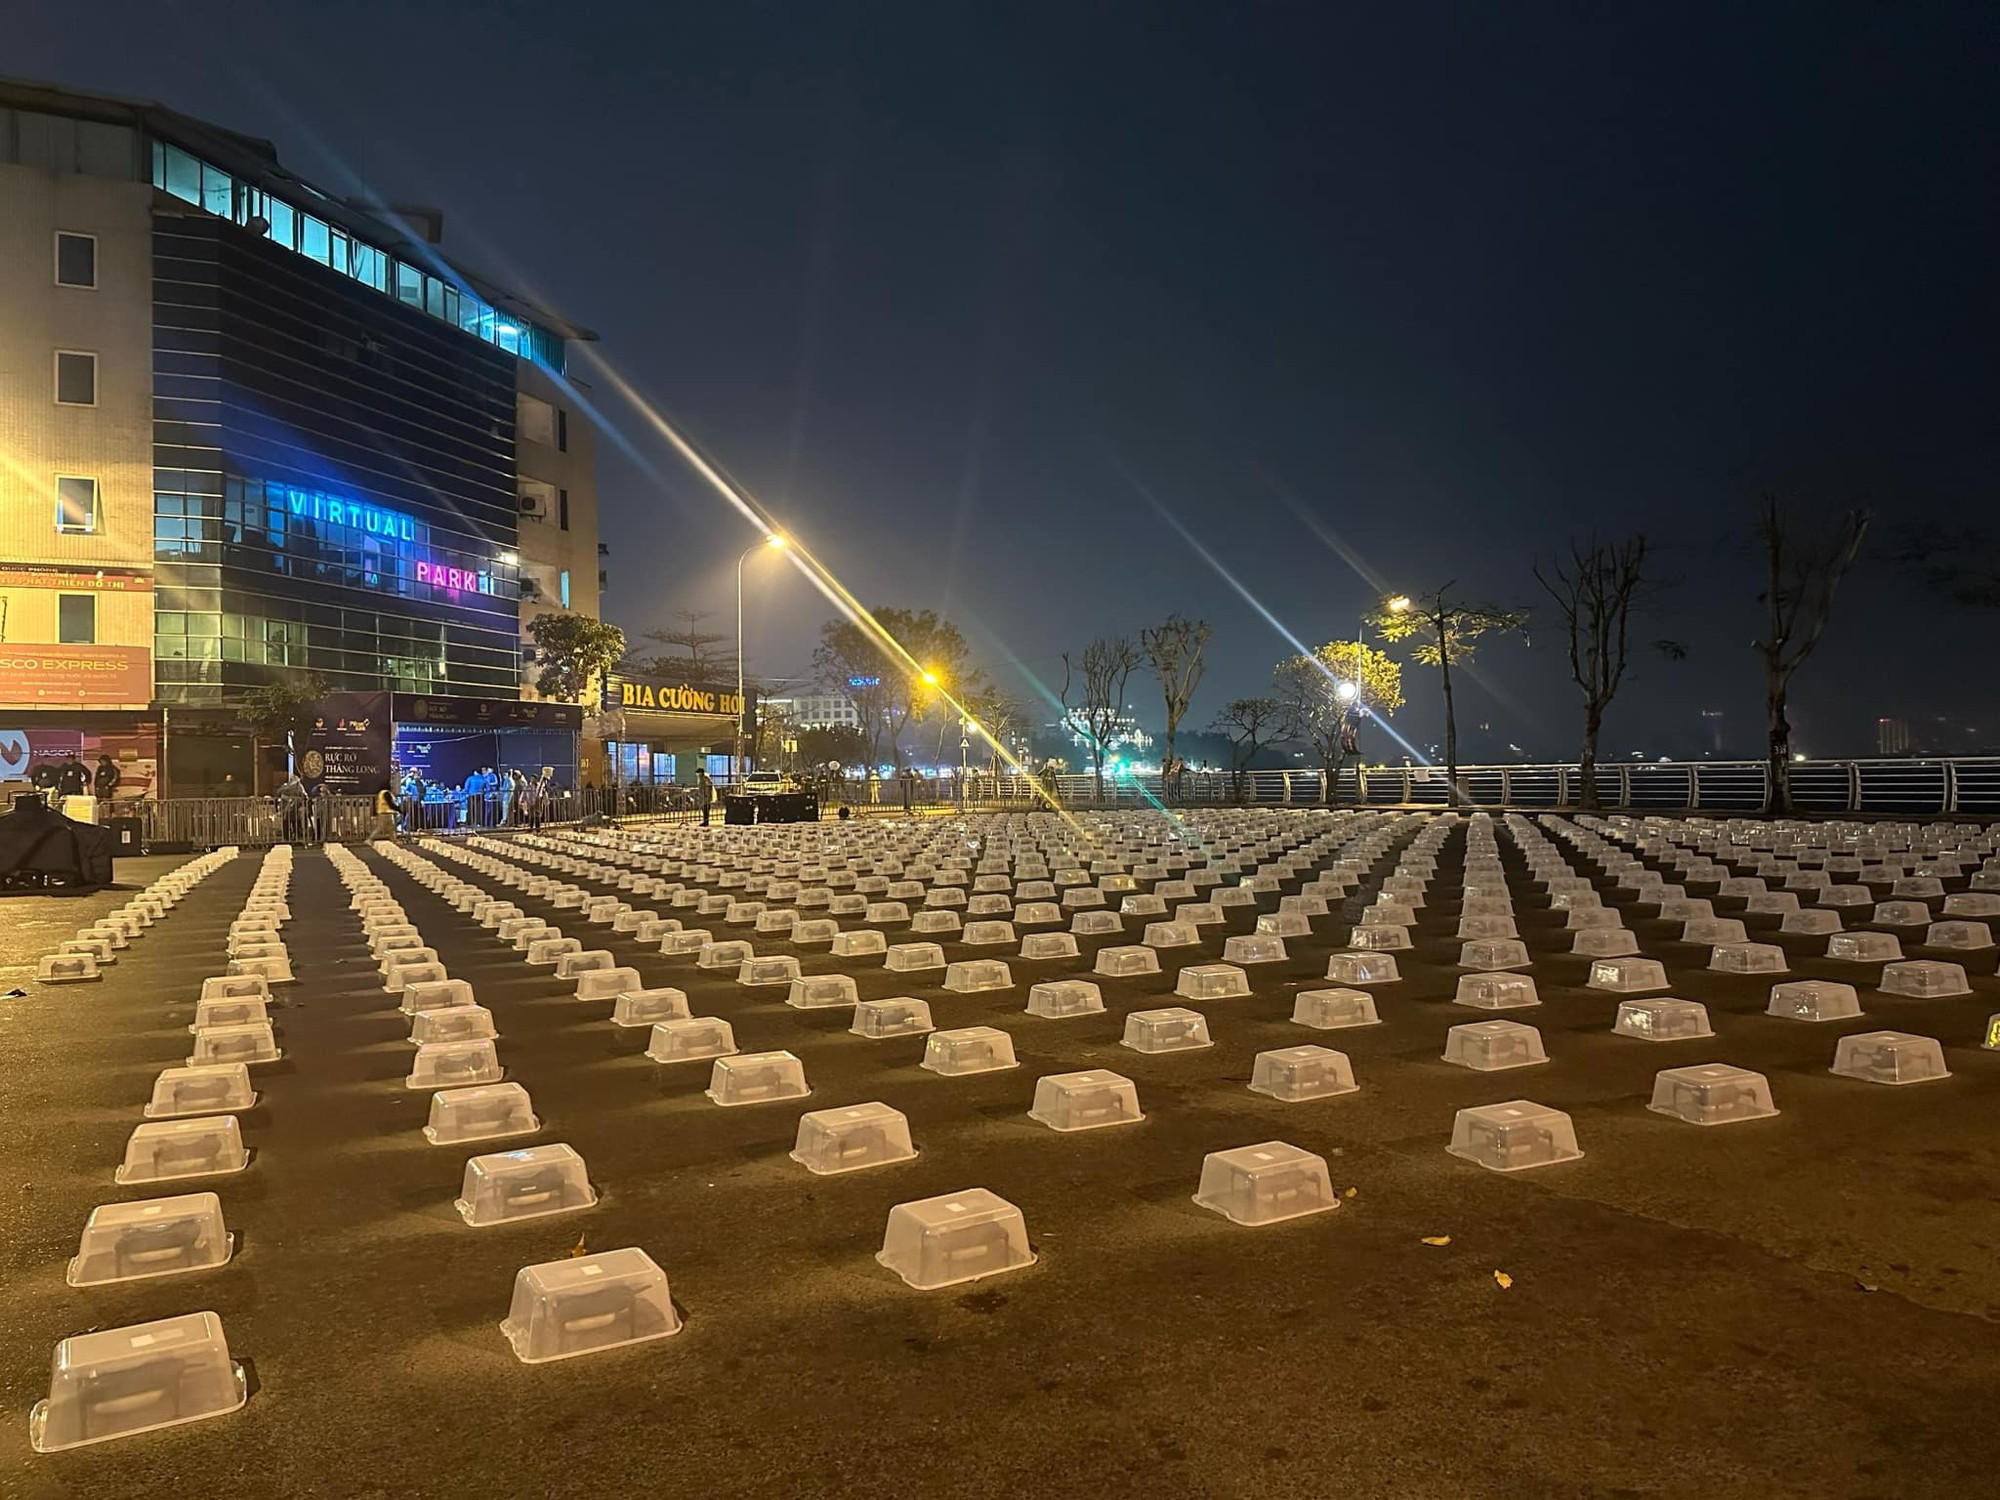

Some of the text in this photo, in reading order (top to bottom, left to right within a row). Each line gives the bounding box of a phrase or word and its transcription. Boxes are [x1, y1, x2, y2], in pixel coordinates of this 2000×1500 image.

[289, 489, 411, 541] VIRTUAL
[416, 561, 476, 593] PARK
[42, 660, 129, 671] EXPRESS
[622, 683, 655, 707] BIA
[659, 683, 715, 712] CƯỜNG
[356, 765, 380, 774] LONG
